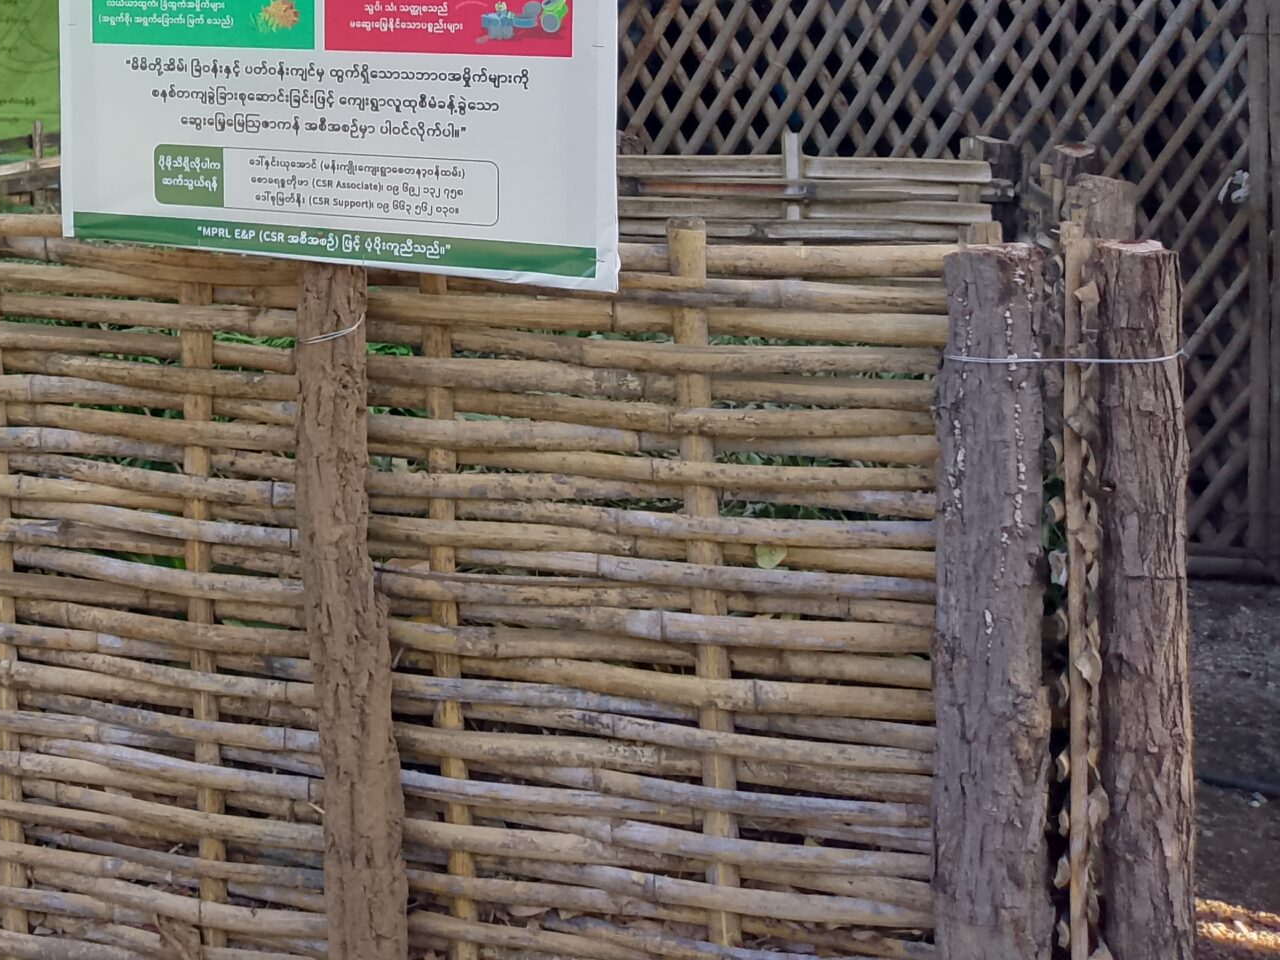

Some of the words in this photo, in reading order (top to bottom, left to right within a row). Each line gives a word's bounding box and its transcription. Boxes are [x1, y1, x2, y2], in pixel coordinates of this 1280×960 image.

[312, 178, 333, 188] (CSR
[308, 196, 330, 207] (CSR
[234, 229, 256, 240] E&P
[259, 230, 285, 243] (CSR
